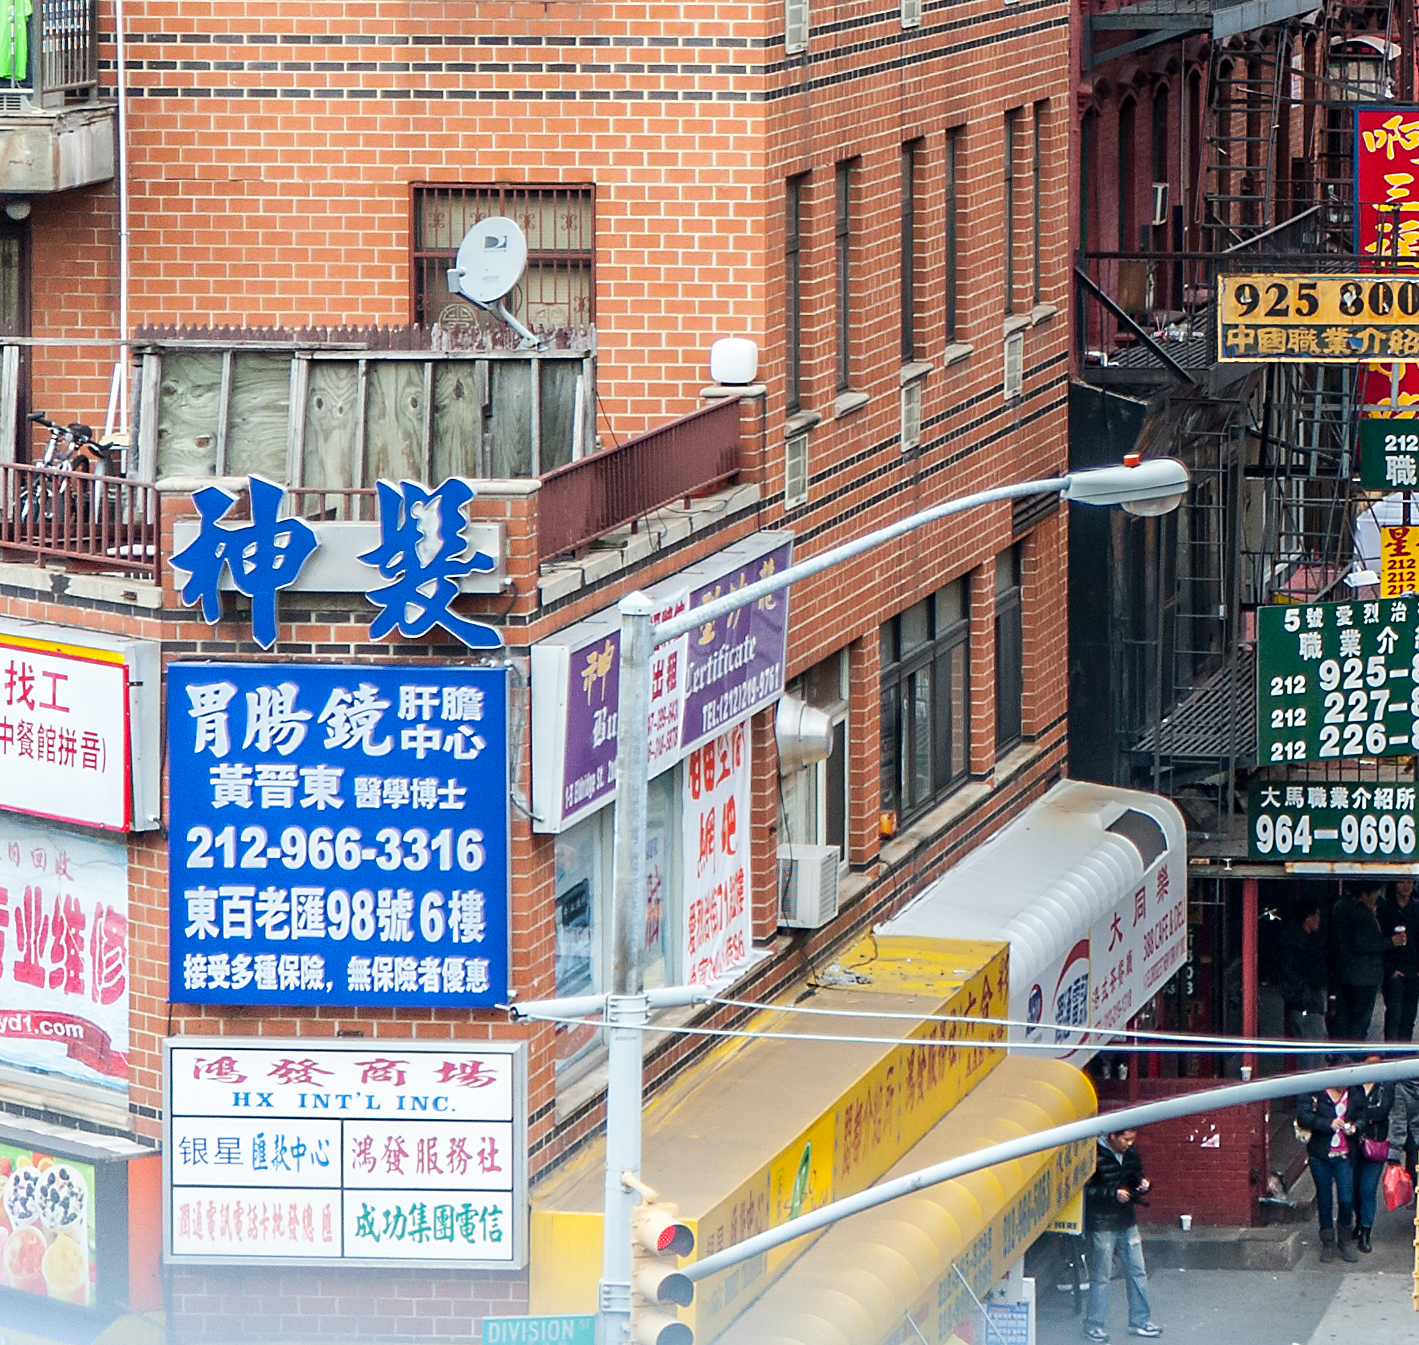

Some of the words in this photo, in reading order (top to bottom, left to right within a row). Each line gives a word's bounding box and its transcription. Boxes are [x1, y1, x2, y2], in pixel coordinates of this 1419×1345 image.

[1235, 282, 1320, 319] 925
[1384, 434, 1418, 453] 212
[3, 661, 72, 714] 找工
[397, 686, 485, 722] 肝膽
[1271, 675, 1306, 697] 212
[185, 682, 395, 758] 胃腸鏡
[1271, 708, 1307, 729] 212
[399, 724, 486, 761] 中心
[1271, 741, 1307, 762] 212
[209, 763, 344, 811] 黃晉東
[353, 777, 467, 811] 醫學博士
[1260, 787, 1417, 811] 大馬職業介紹所
[185, 826, 484, 871] 212-966-3316
[1255, 813, 1417, 854] 964-9696
[0, 885, 128, 1005] 业维修
[232, 1092, 274, 1108] HX
[299, 1092, 381, 1110] INT'L
[397, 1095, 456, 1112] INC.
[355, 1202, 503, 1244] 成功集團電信
[488, 1319, 575, 1343] DIVISION
